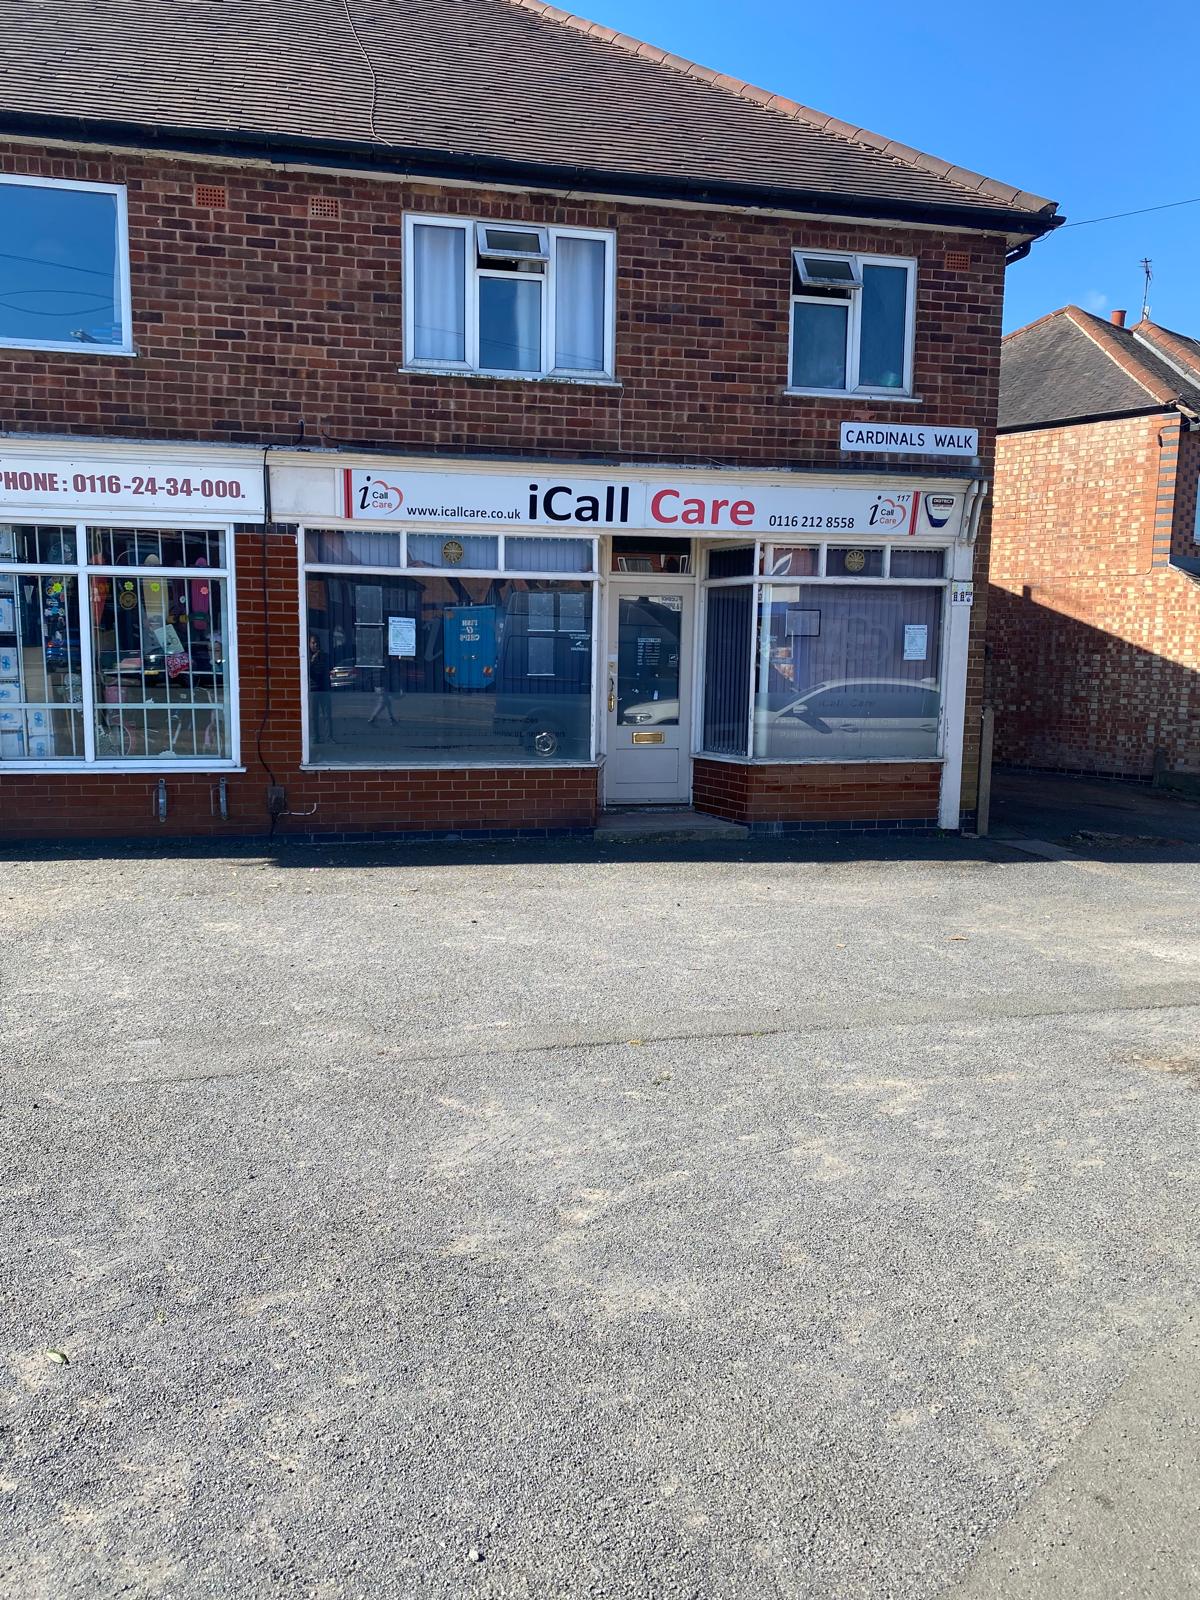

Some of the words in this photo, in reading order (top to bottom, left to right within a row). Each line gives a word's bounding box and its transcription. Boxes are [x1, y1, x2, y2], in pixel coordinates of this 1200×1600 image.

[846, 430, 925, 447] CARDINALS
[934, 433, 973, 449] WALK
[0, 471, 68, 492] HONE:
[372, 491, 389, 500] Call
[897, 494, 911, 502] 117
[372, 500, 393, 509] Care
[528, 483, 630, 523] iCall
[650, 488, 756, 526] Care
[406, 505, 521, 520] www.icallcare.co.uk
[880, 508, 895, 516] Call
[768, 514, 799, 528] 0116
[800, 515, 823, 528] 212
[825, 516, 855, 529] 8558
[879, 517, 897, 525] Care
[953, 591, 973, 603] 117
